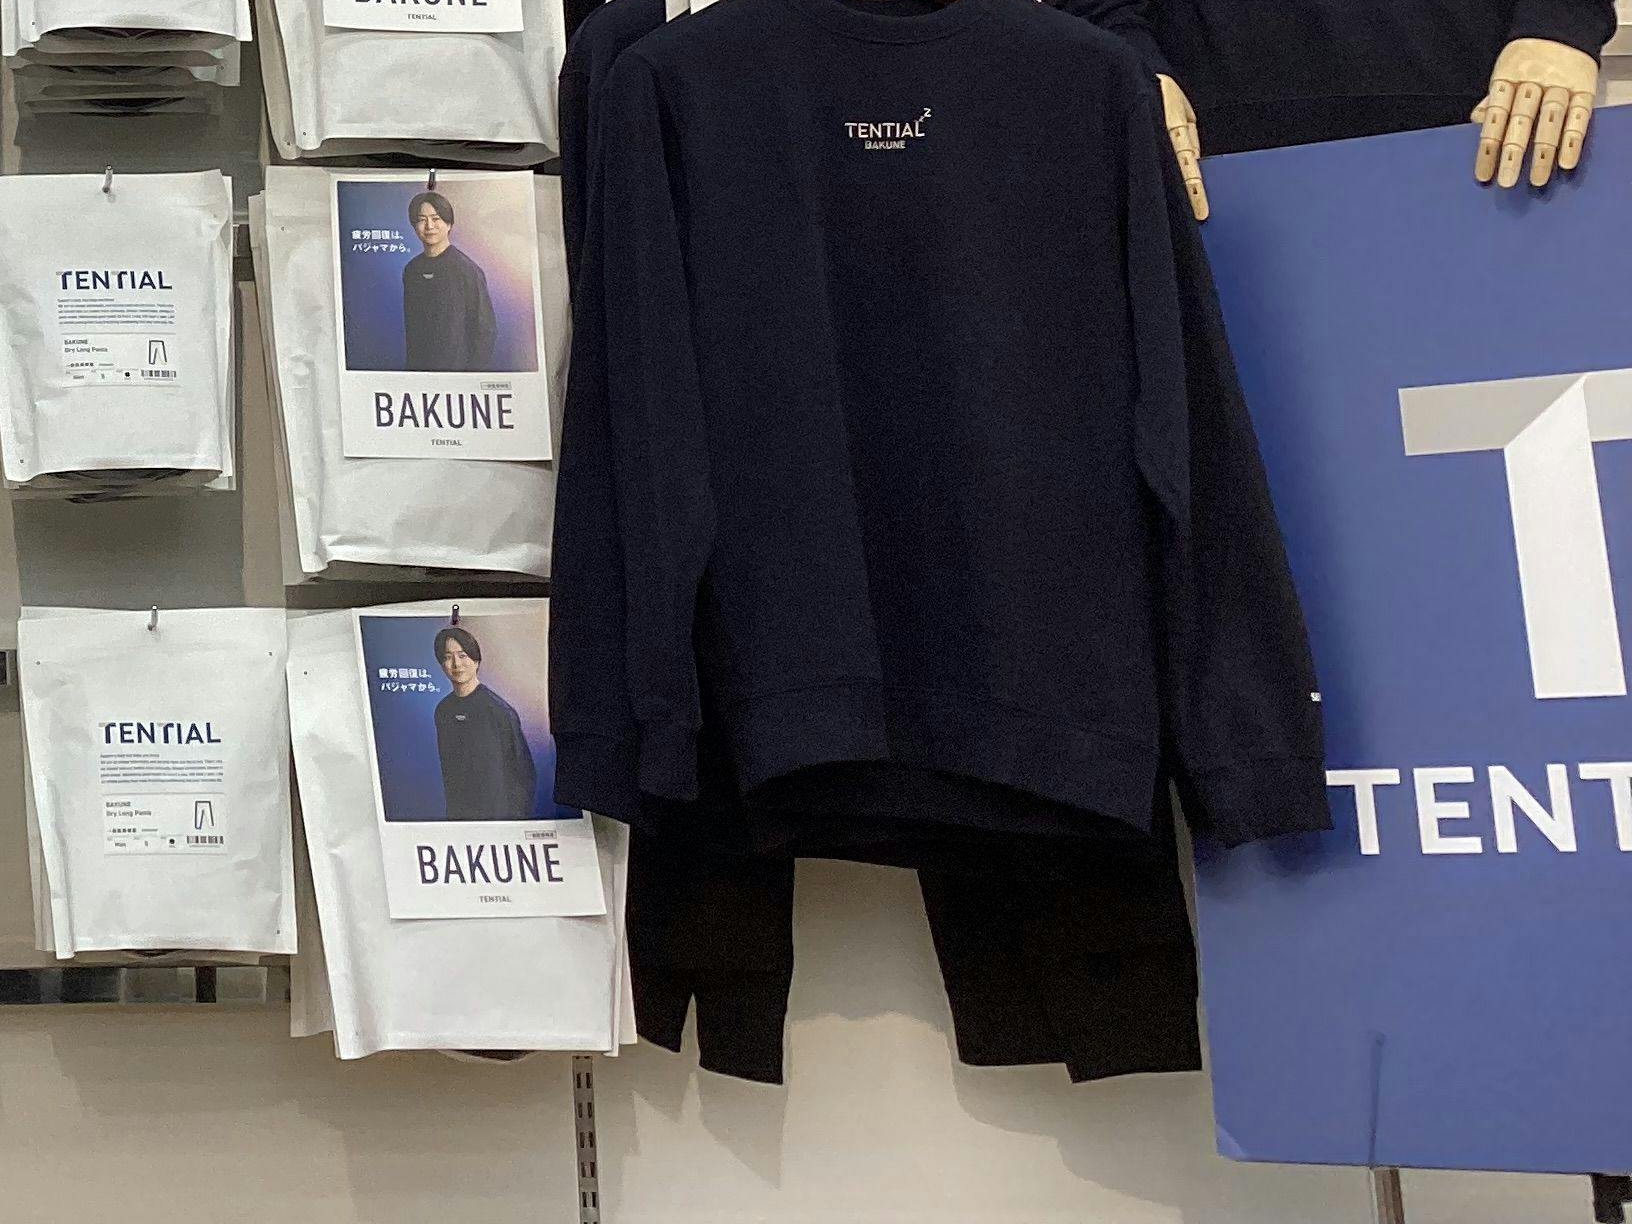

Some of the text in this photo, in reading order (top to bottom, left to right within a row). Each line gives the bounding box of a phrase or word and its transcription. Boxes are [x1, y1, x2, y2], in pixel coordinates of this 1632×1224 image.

[55, 270, 173, 291] TENTIAL
[374, 391, 515, 430] BAKUNE
[98, 722, 222, 745] TENTIAL
[416, 842, 565, 885] BAKUNE
